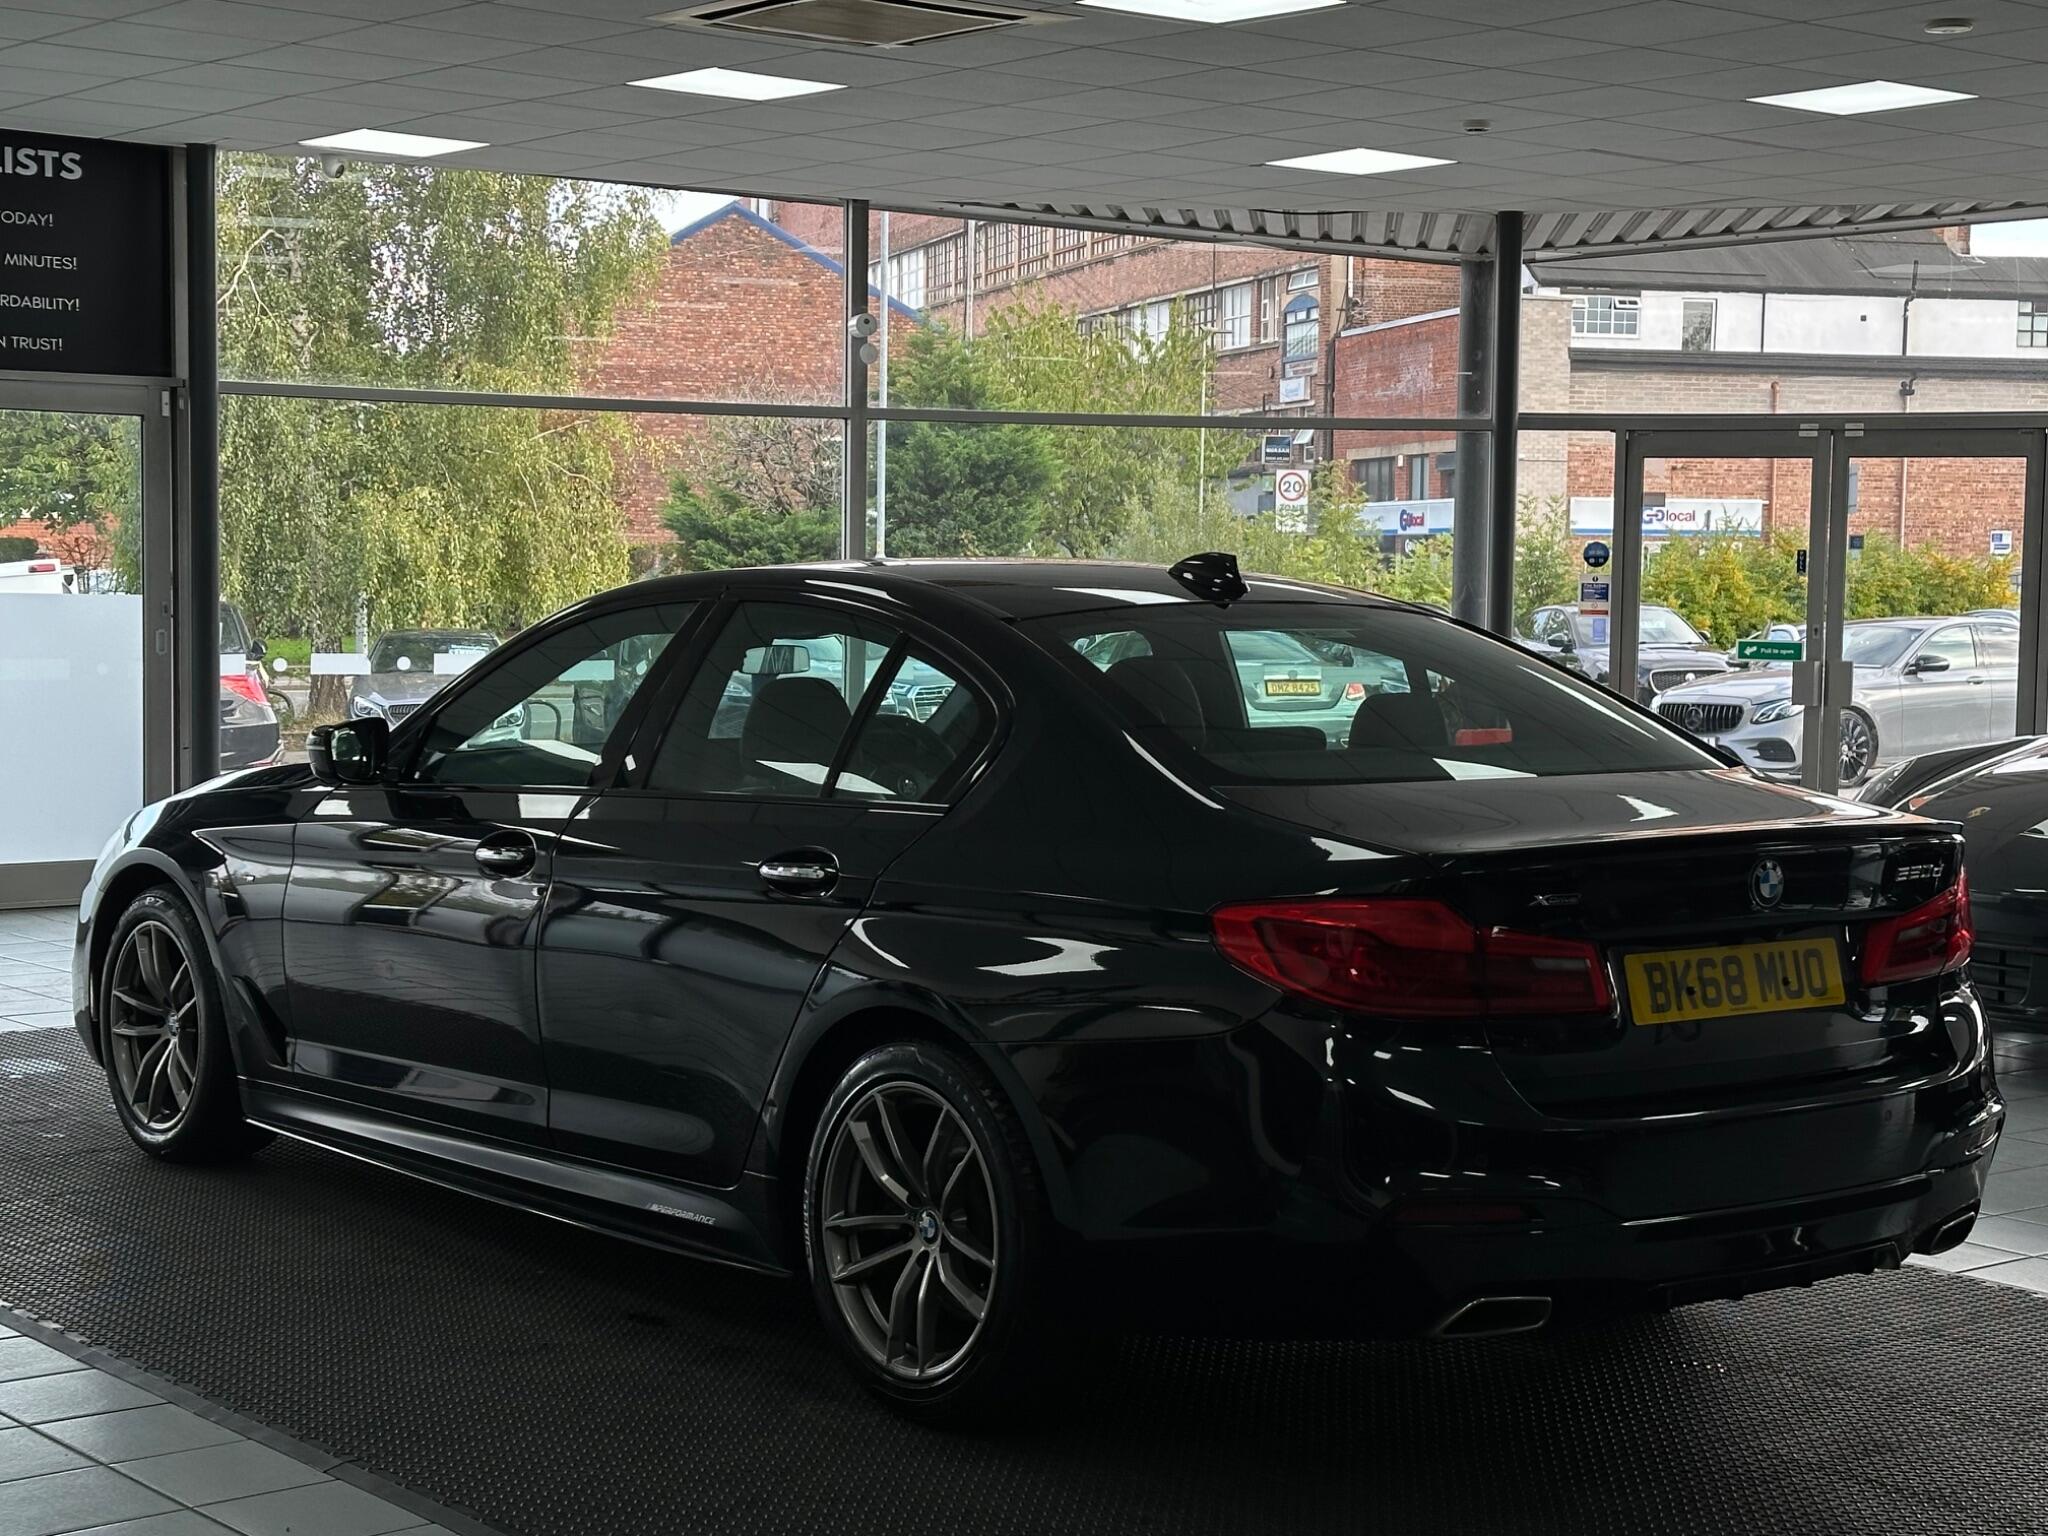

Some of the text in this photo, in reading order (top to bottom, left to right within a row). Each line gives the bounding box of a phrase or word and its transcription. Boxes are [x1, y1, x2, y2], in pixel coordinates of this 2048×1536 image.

[0, 210, 54, 228] ODAY!
[4, 252, 78, 271] MINUTES!
[0, 293, 81, 312] RDABILITY!
[11, 336, 63, 352] TRUST!
[1283, 480, 1302, 493] 20
[1643, 947, 1828, 1014] BK68 MUO
